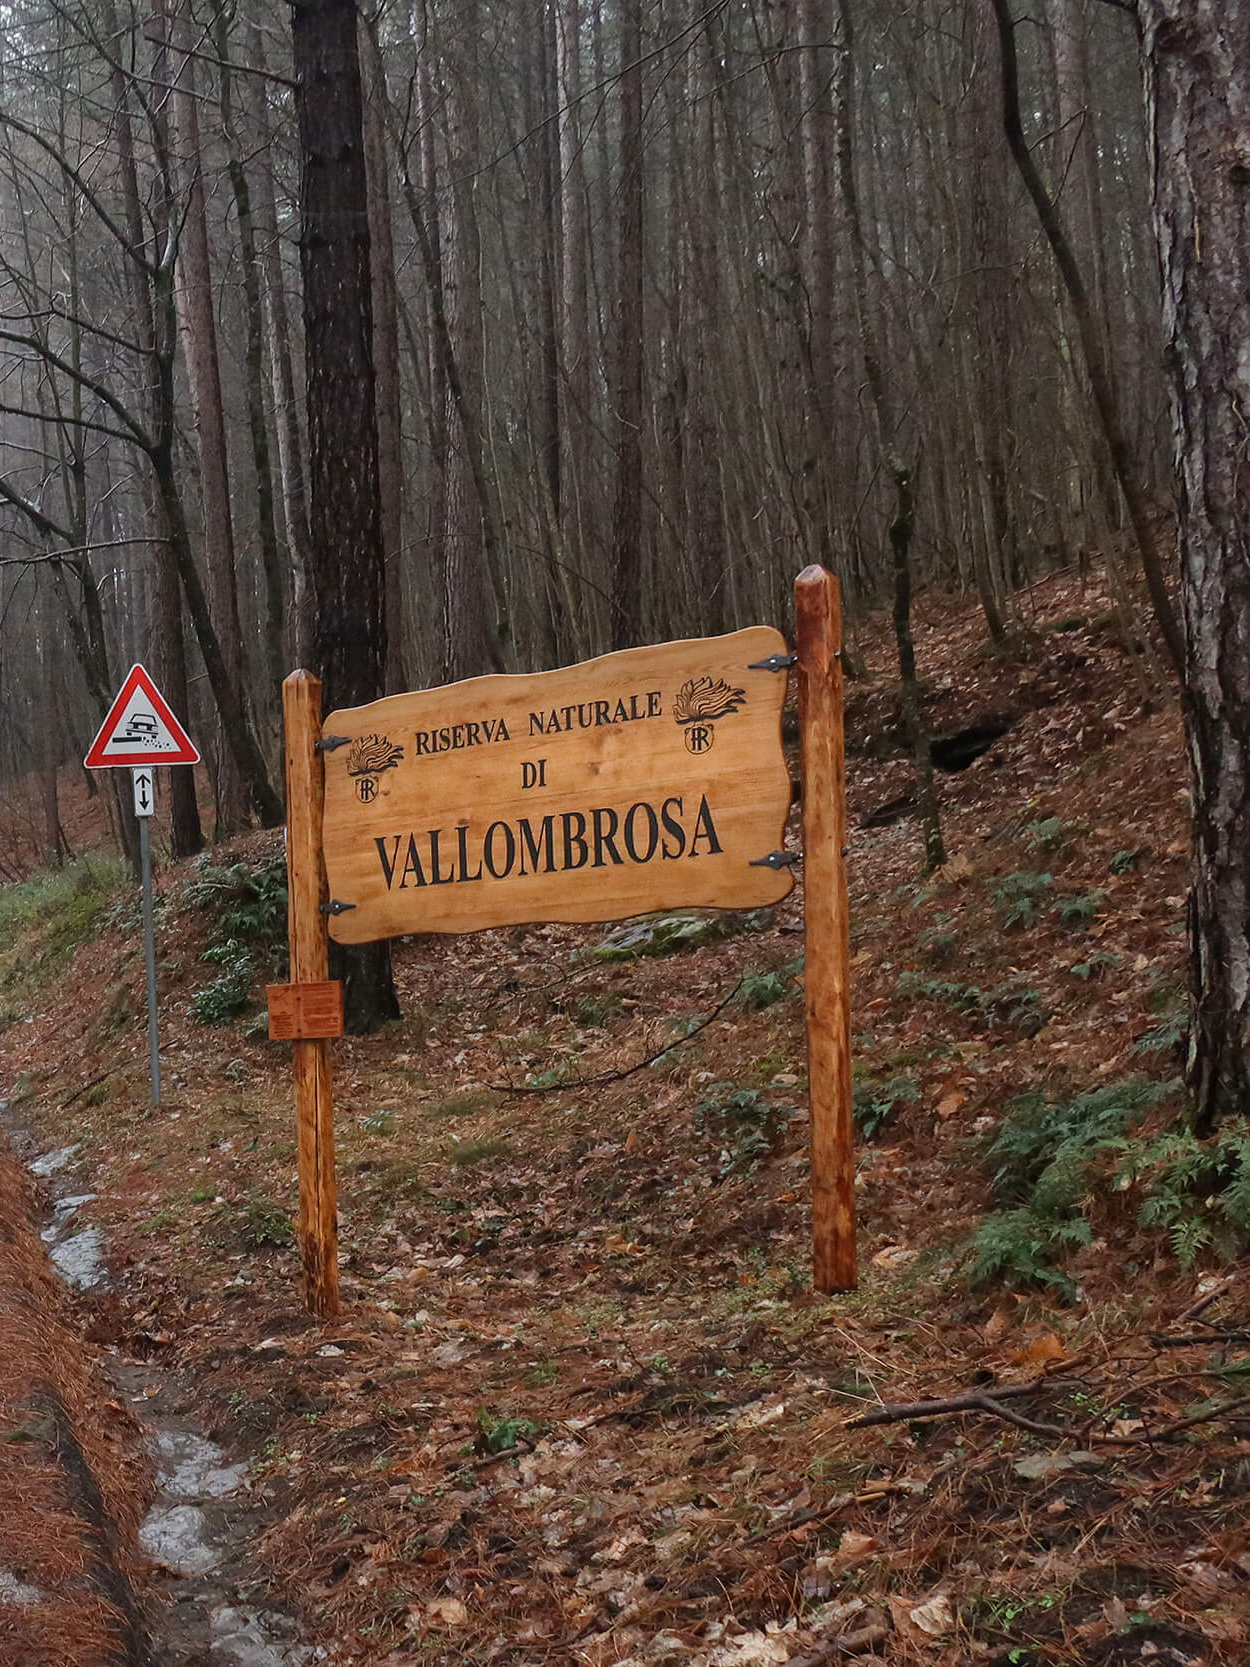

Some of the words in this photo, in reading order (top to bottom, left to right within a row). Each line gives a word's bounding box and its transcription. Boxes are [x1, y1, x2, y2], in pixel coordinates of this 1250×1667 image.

[414, 718, 511, 756] RISERVA
[528, 691, 663, 737] NATURALE
[521, 759, 547, 789] DI
[374, 794, 724, 890] VALLOMBROSA
